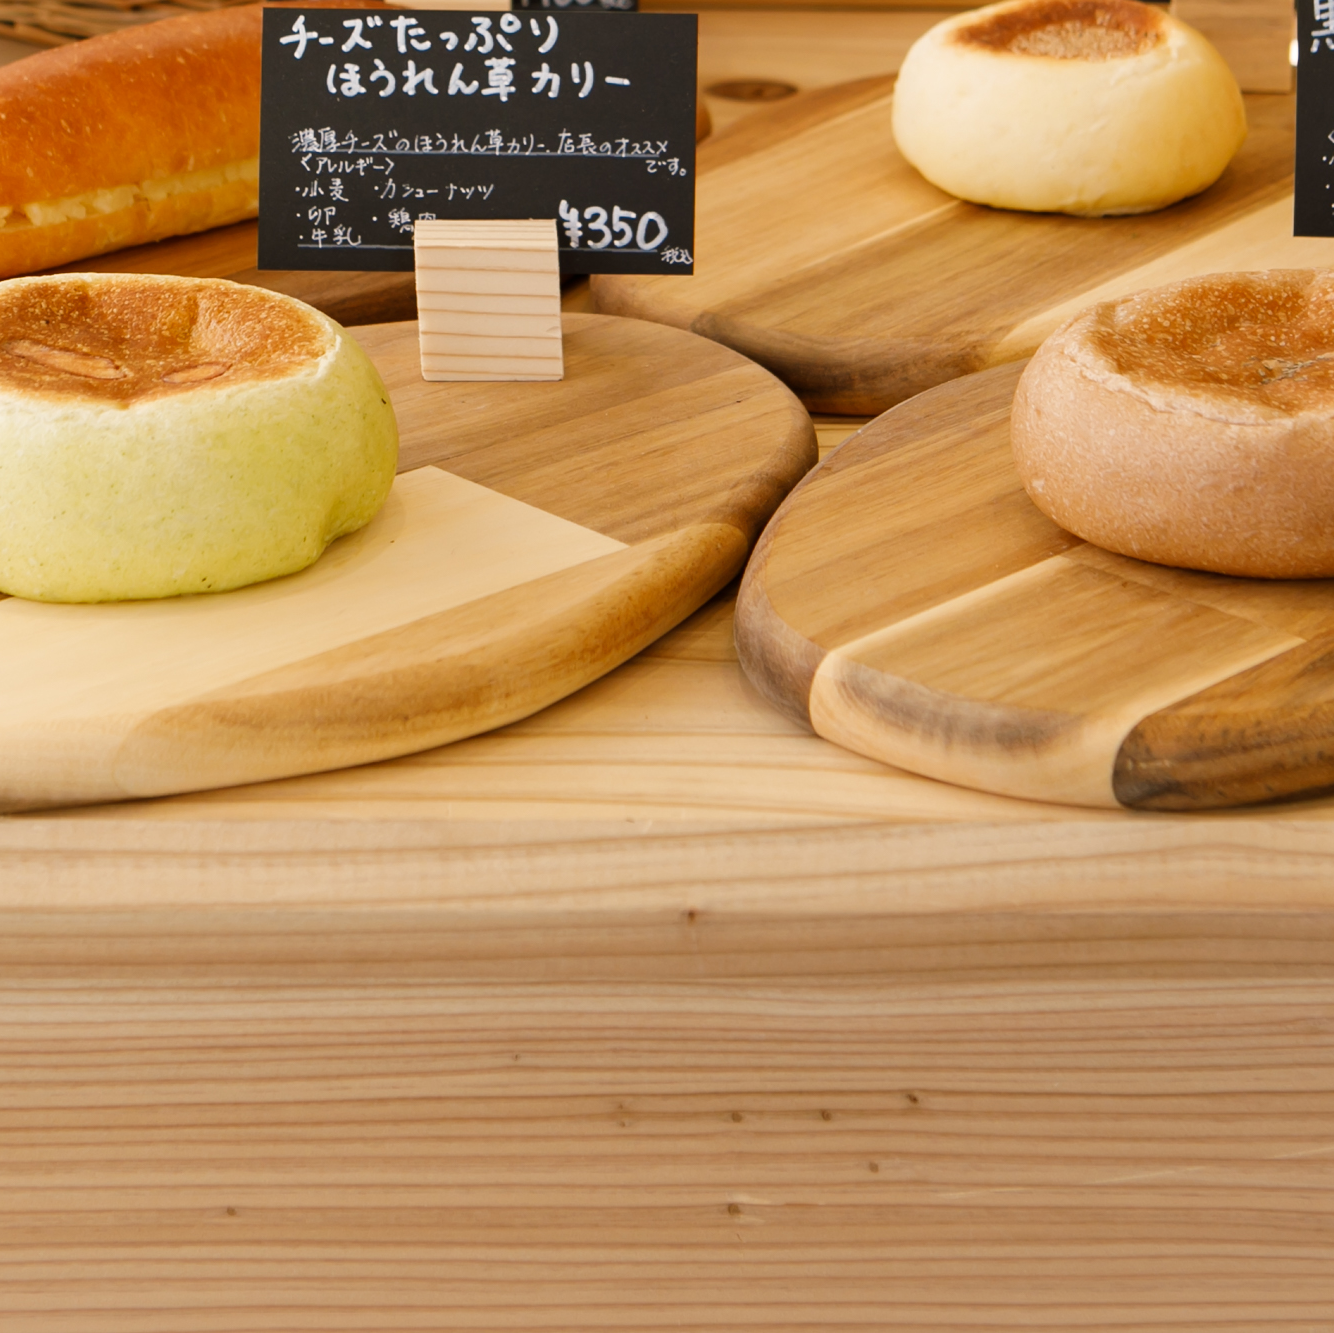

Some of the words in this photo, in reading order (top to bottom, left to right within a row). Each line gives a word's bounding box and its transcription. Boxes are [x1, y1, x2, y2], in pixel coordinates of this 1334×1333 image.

[280, 14, 560, 59] チーズたっぷり
[326, 59, 631, 102] ほうれん草カリー
[558, 198, 668, 250] ¥350
